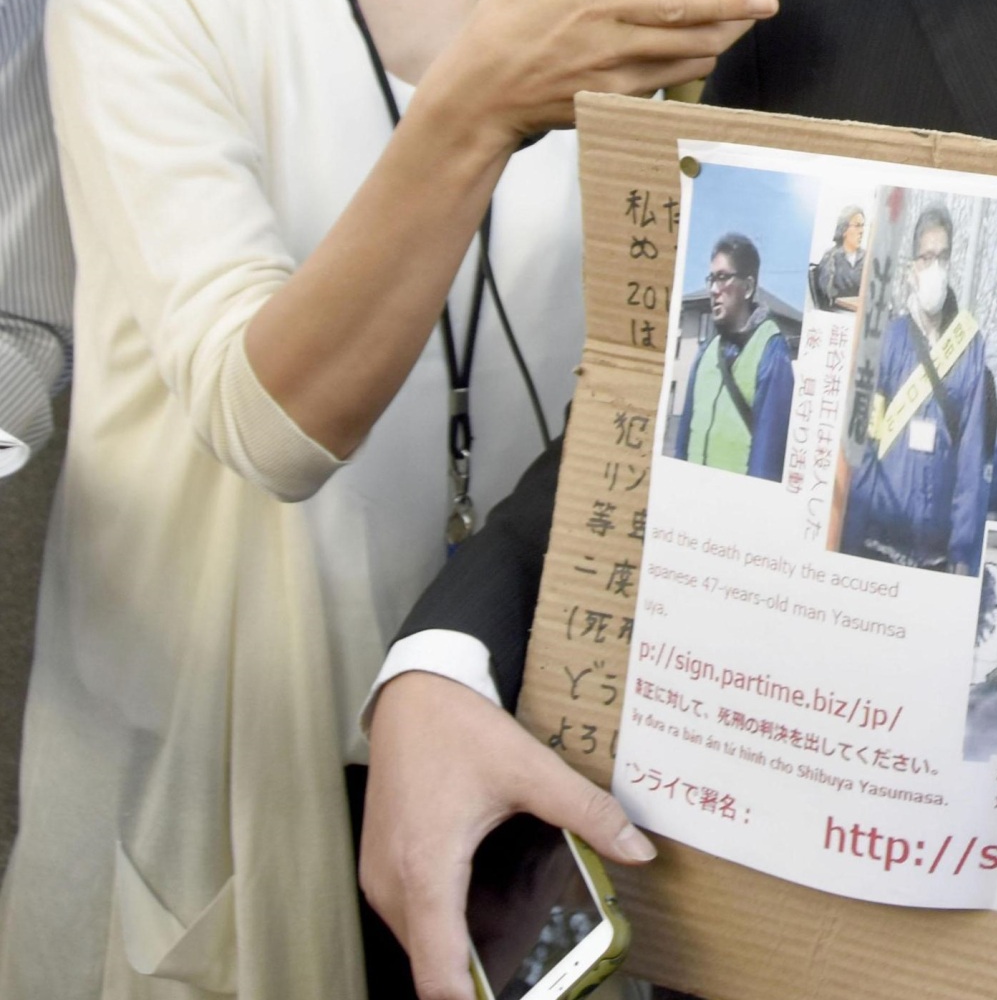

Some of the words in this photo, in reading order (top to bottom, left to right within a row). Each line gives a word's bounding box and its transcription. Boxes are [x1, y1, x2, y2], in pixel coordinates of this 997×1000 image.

[613, 410, 650, 458] 犯
[652, 527, 674, 543] and
[677, 531, 698, 550] the
[702, 538, 741, 561] death
[744, 552, 797, 579] penalty
[801, 562, 826, 583] the
[830, 573, 900, 598] accused
[702, 576, 789, 613] 47-years-old
[793, 602, 826, 623] man
[831, 608, 907, 639] Yasumsa
[638, 641, 904, 733] p://sign.partime.biz/jp/
[769, 756, 794, 775] cho
[796, 763, 854, 792] Shibuya
[859, 779, 949, 806] Yasumasa.
